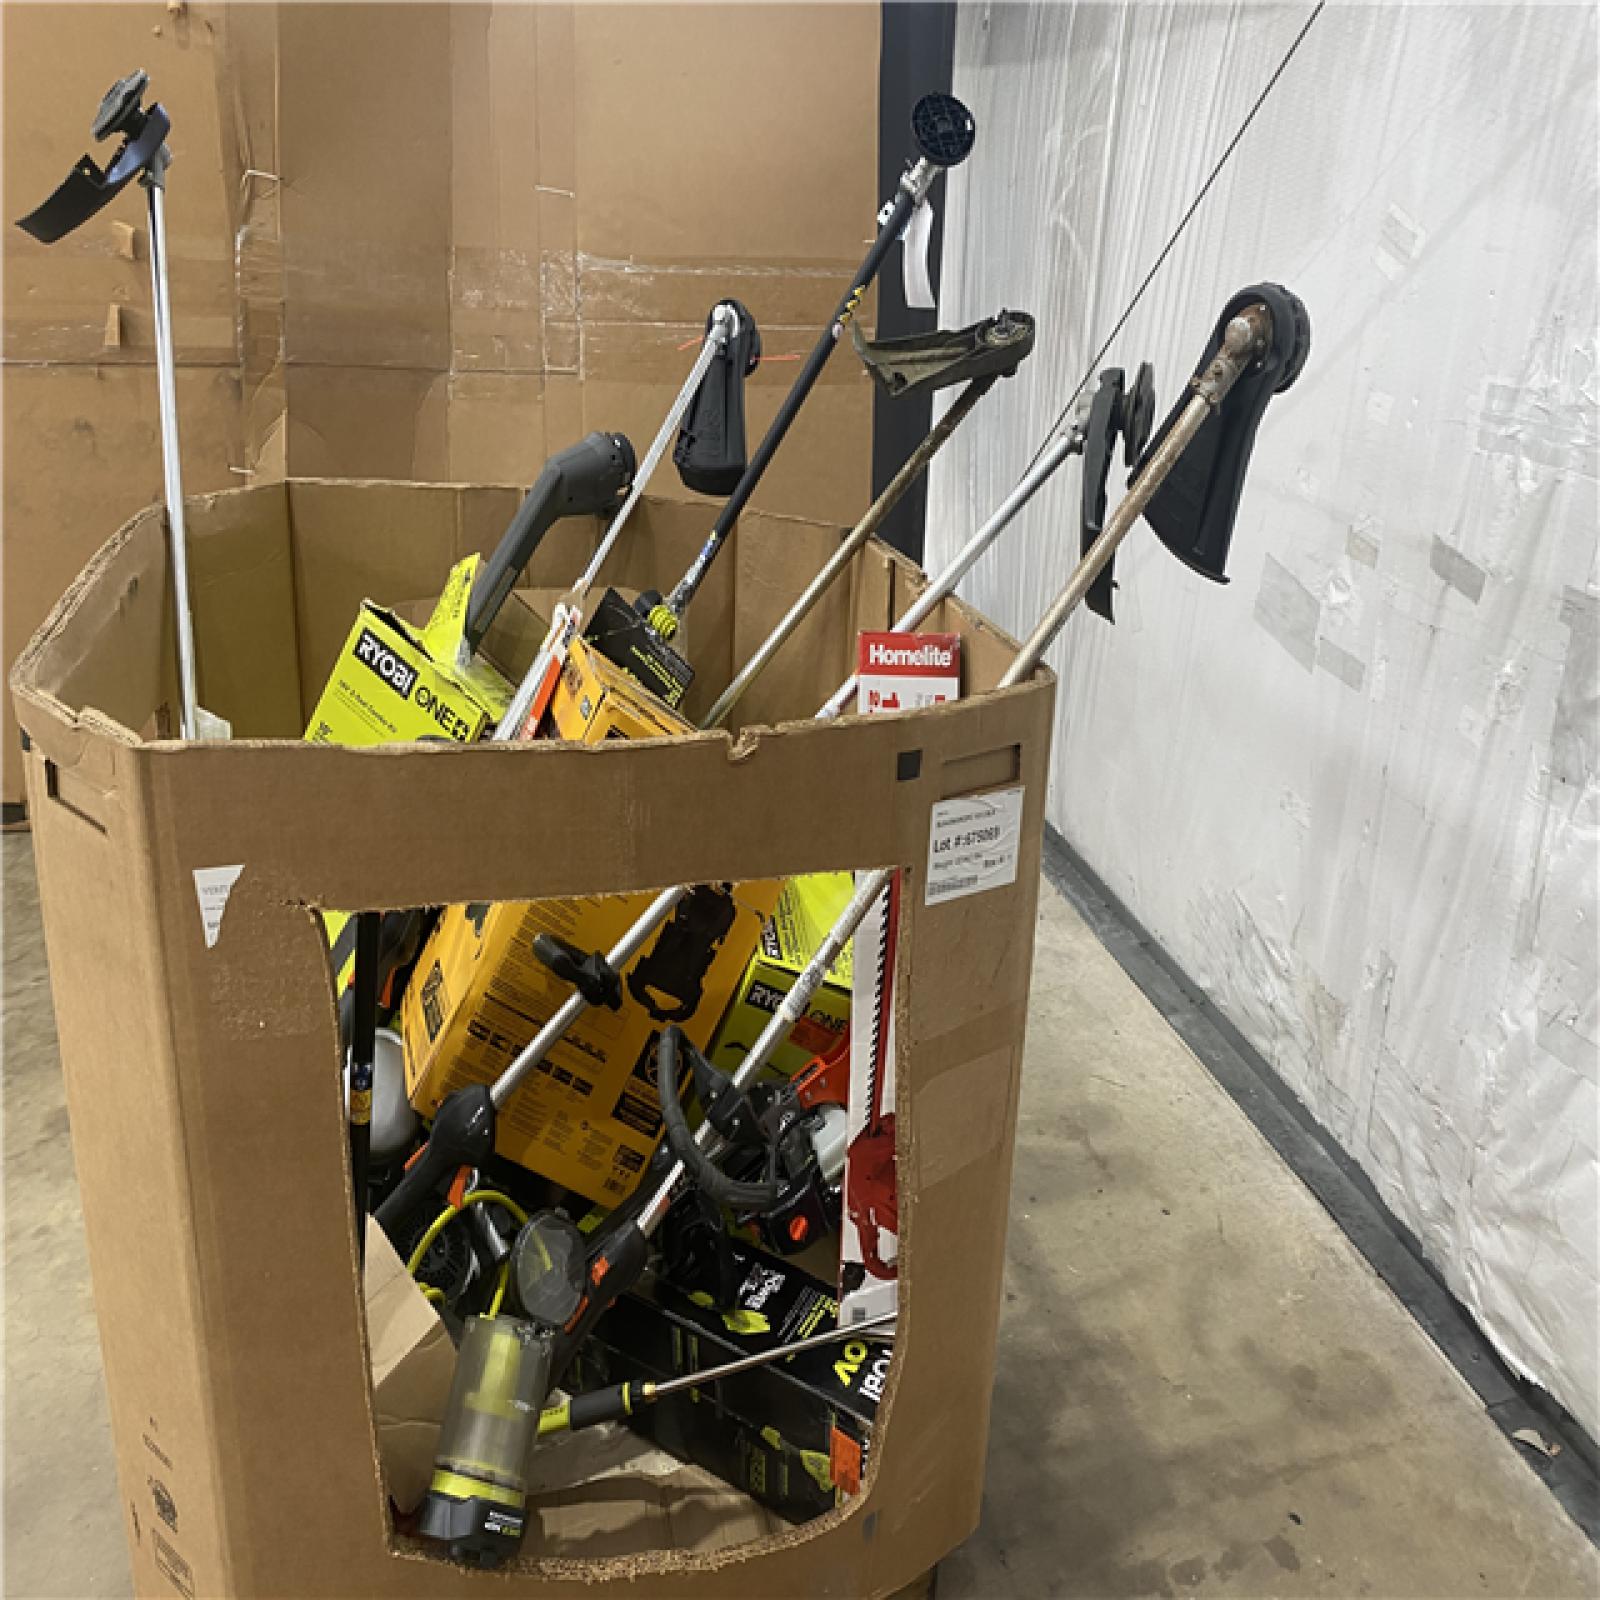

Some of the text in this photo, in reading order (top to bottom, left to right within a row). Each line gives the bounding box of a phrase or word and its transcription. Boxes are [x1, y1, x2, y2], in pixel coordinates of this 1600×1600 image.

[357, 633, 414, 697] RYOBI
[869, 644, 952, 667] Homelite
[934, 836, 950, 853] Lot
